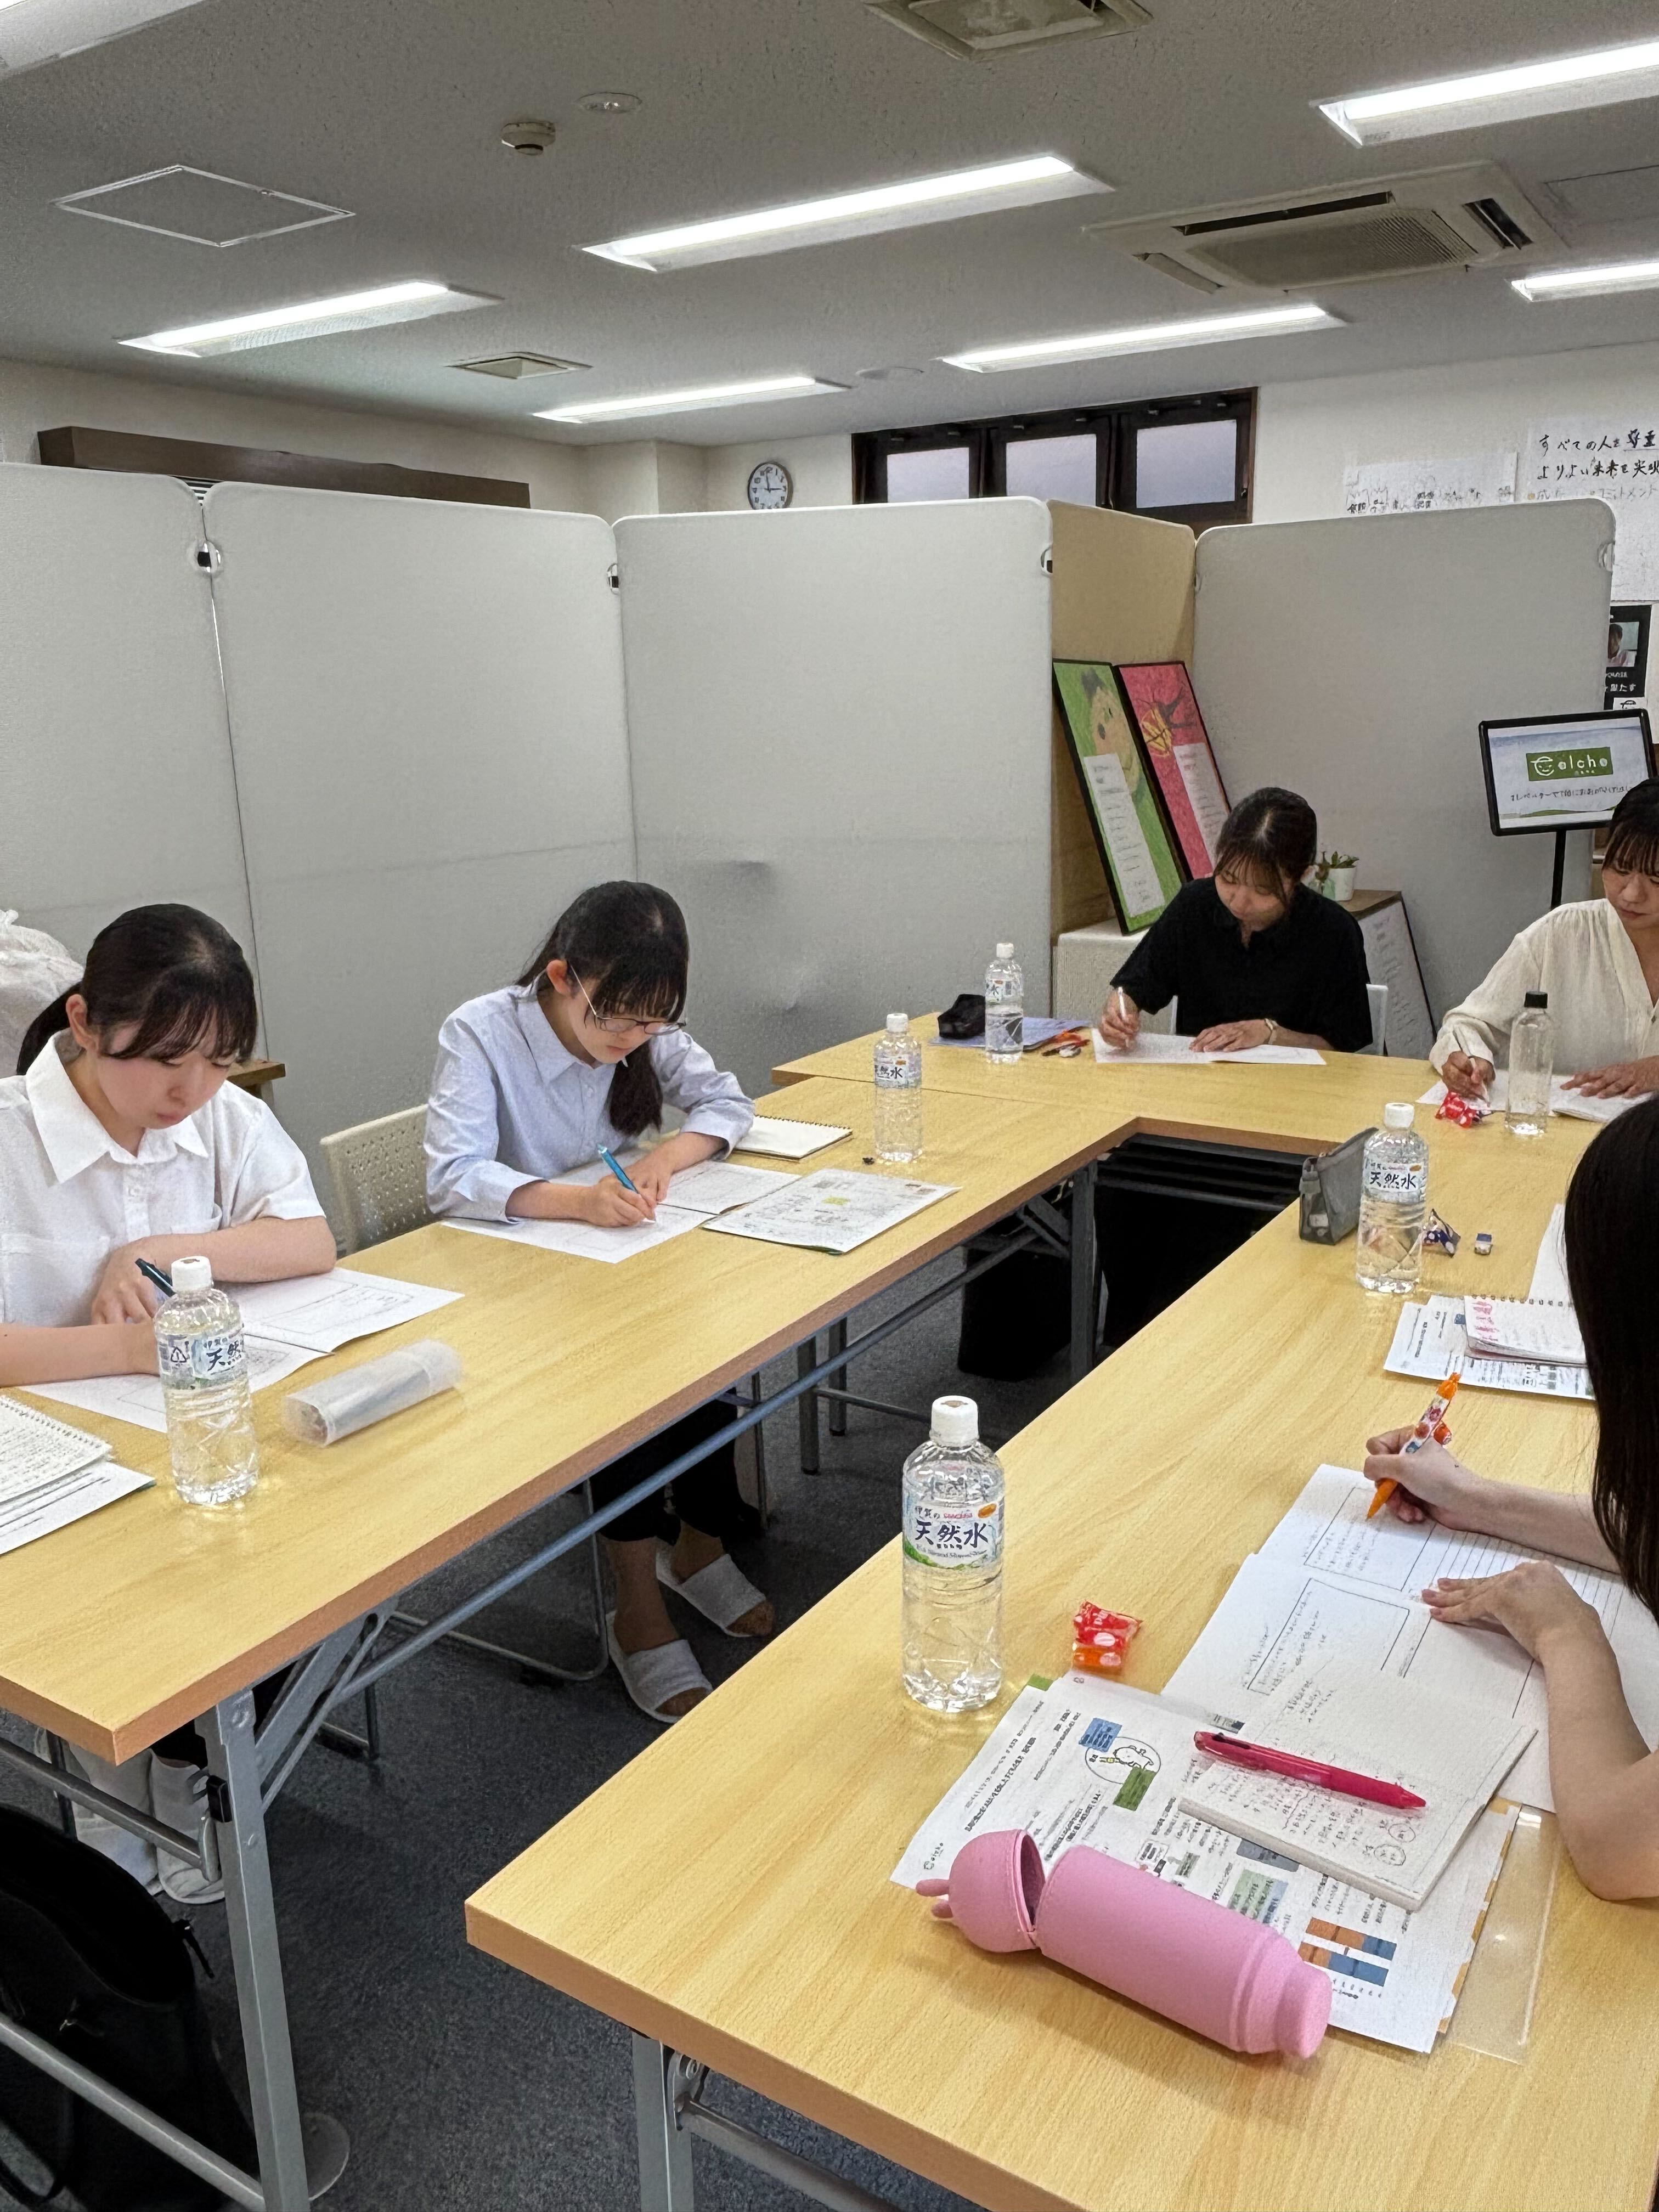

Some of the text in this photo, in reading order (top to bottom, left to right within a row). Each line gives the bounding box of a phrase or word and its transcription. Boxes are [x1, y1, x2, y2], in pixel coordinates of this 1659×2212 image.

[1369, 1171, 1417, 1190] 天然水
[915, 1519, 989, 1550] 天然水
